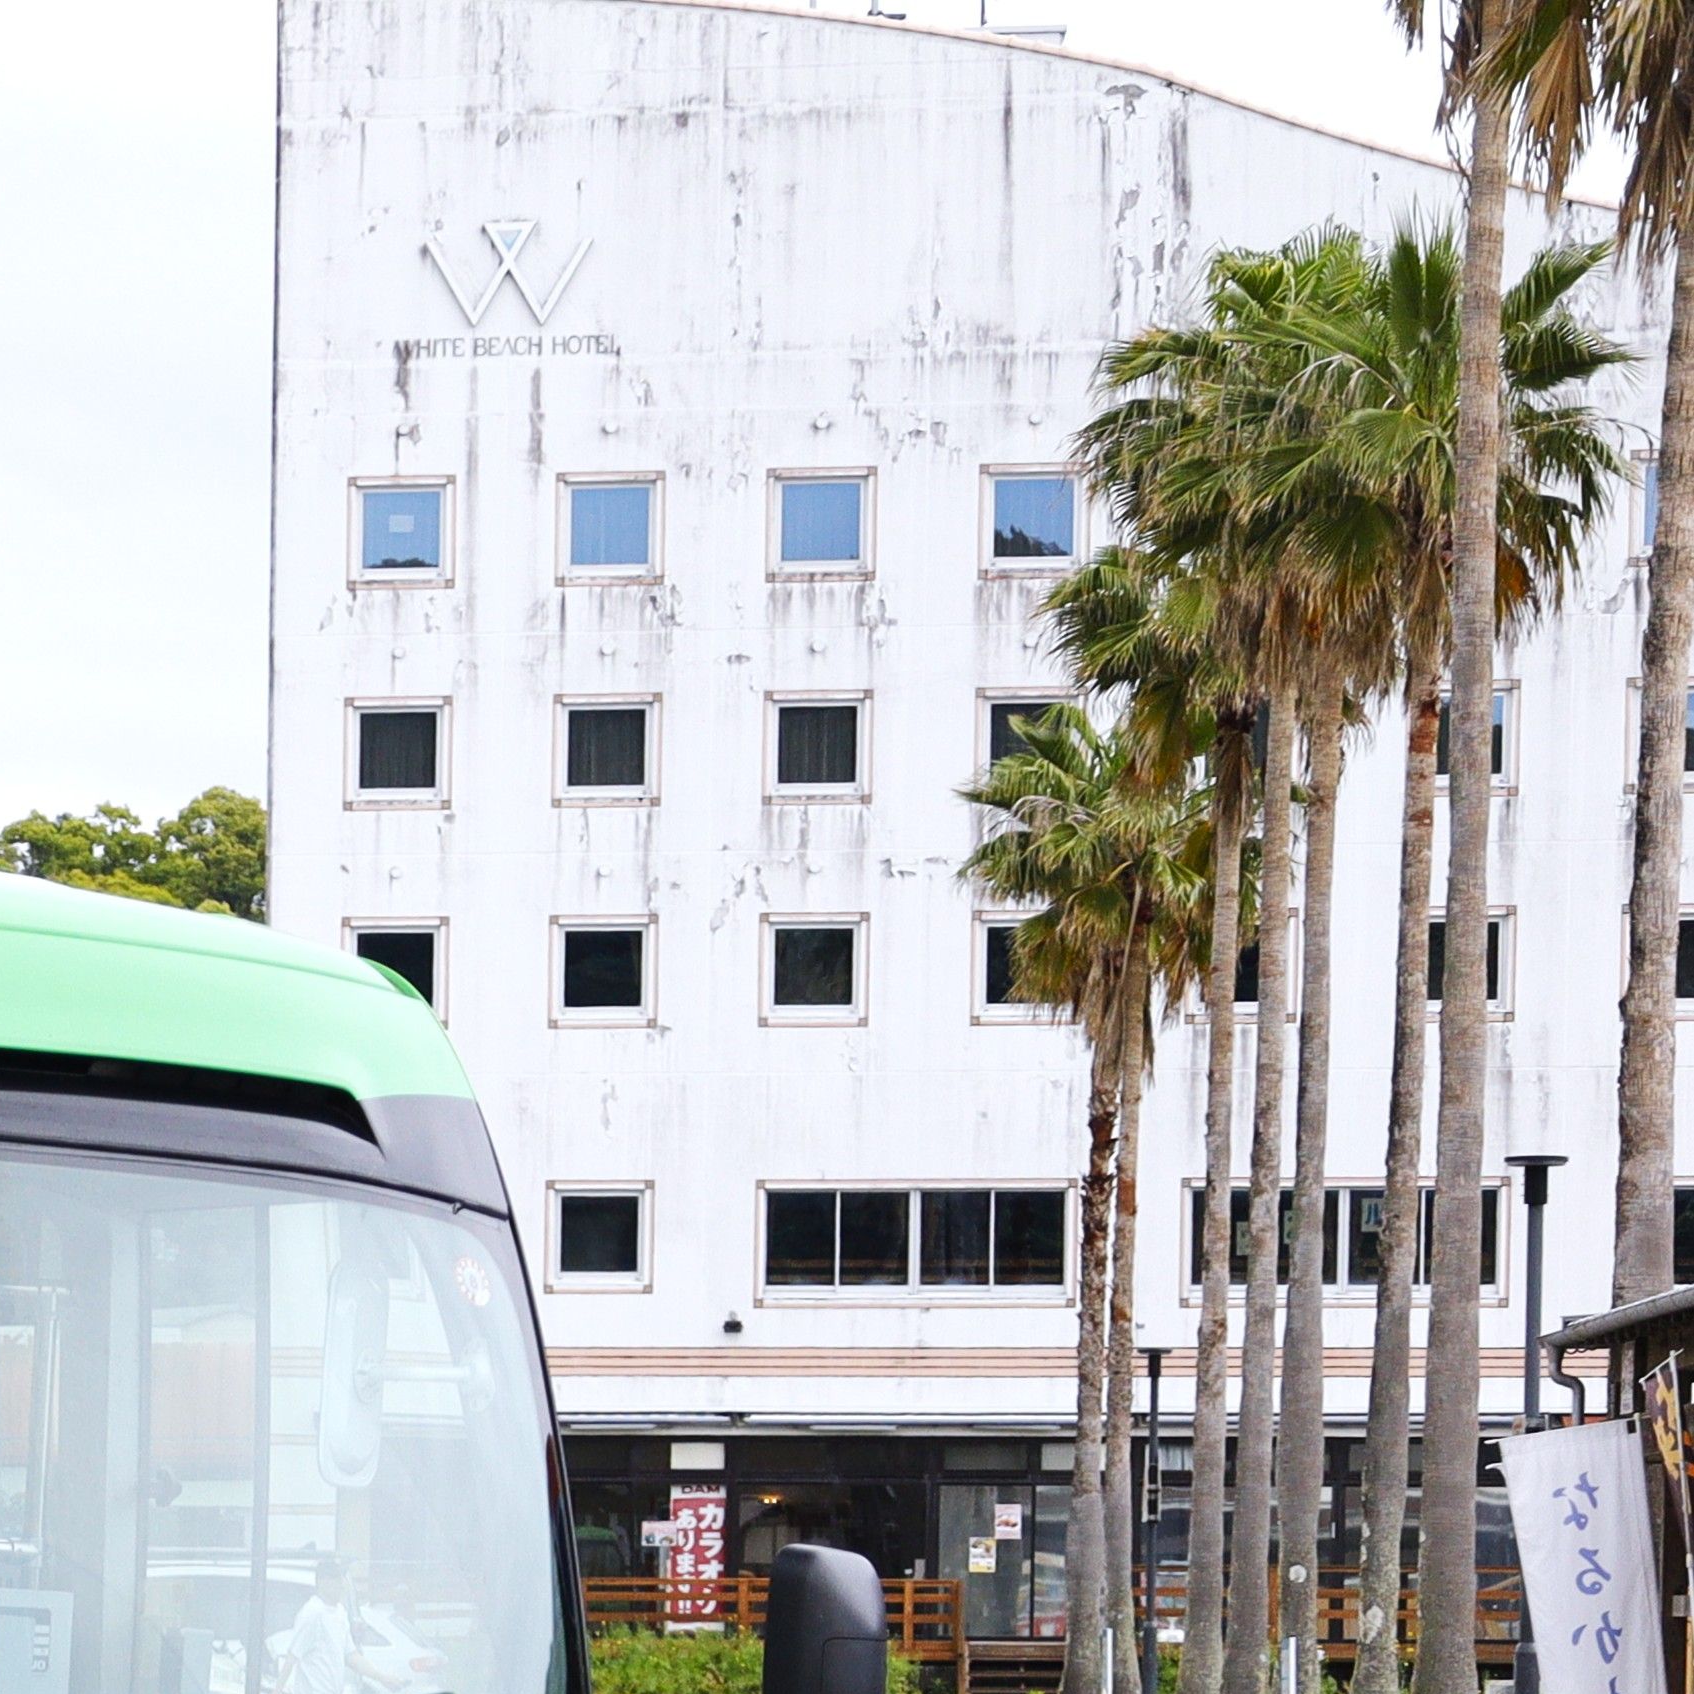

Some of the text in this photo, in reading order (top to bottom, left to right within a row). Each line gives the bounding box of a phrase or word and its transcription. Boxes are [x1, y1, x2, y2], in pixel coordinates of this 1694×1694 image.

[393, 334, 618, 359] WHITE BEACH HOTEL
